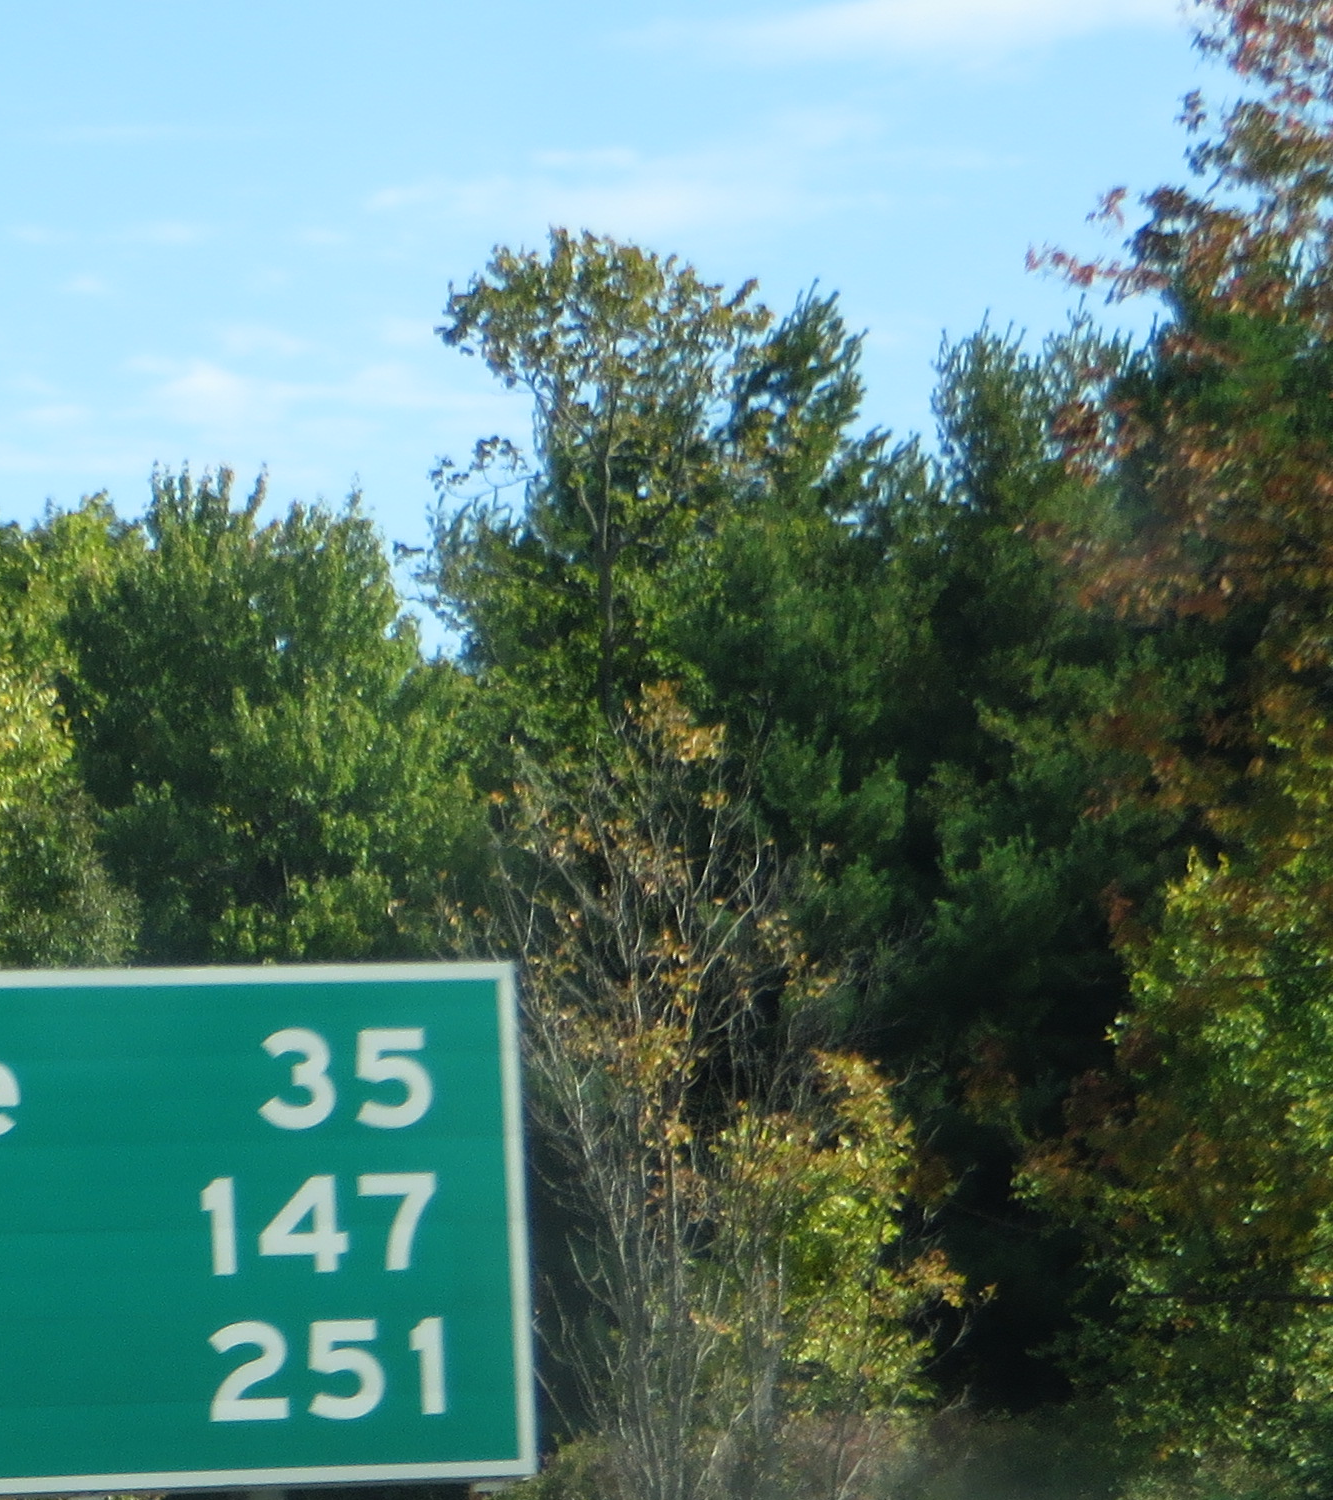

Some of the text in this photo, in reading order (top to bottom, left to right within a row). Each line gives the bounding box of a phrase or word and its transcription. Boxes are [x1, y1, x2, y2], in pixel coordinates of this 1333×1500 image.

[260, 1028, 432, 1129] 35
[201, 1172, 435, 1275] 147
[209, 1317, 445, 1422] 251
